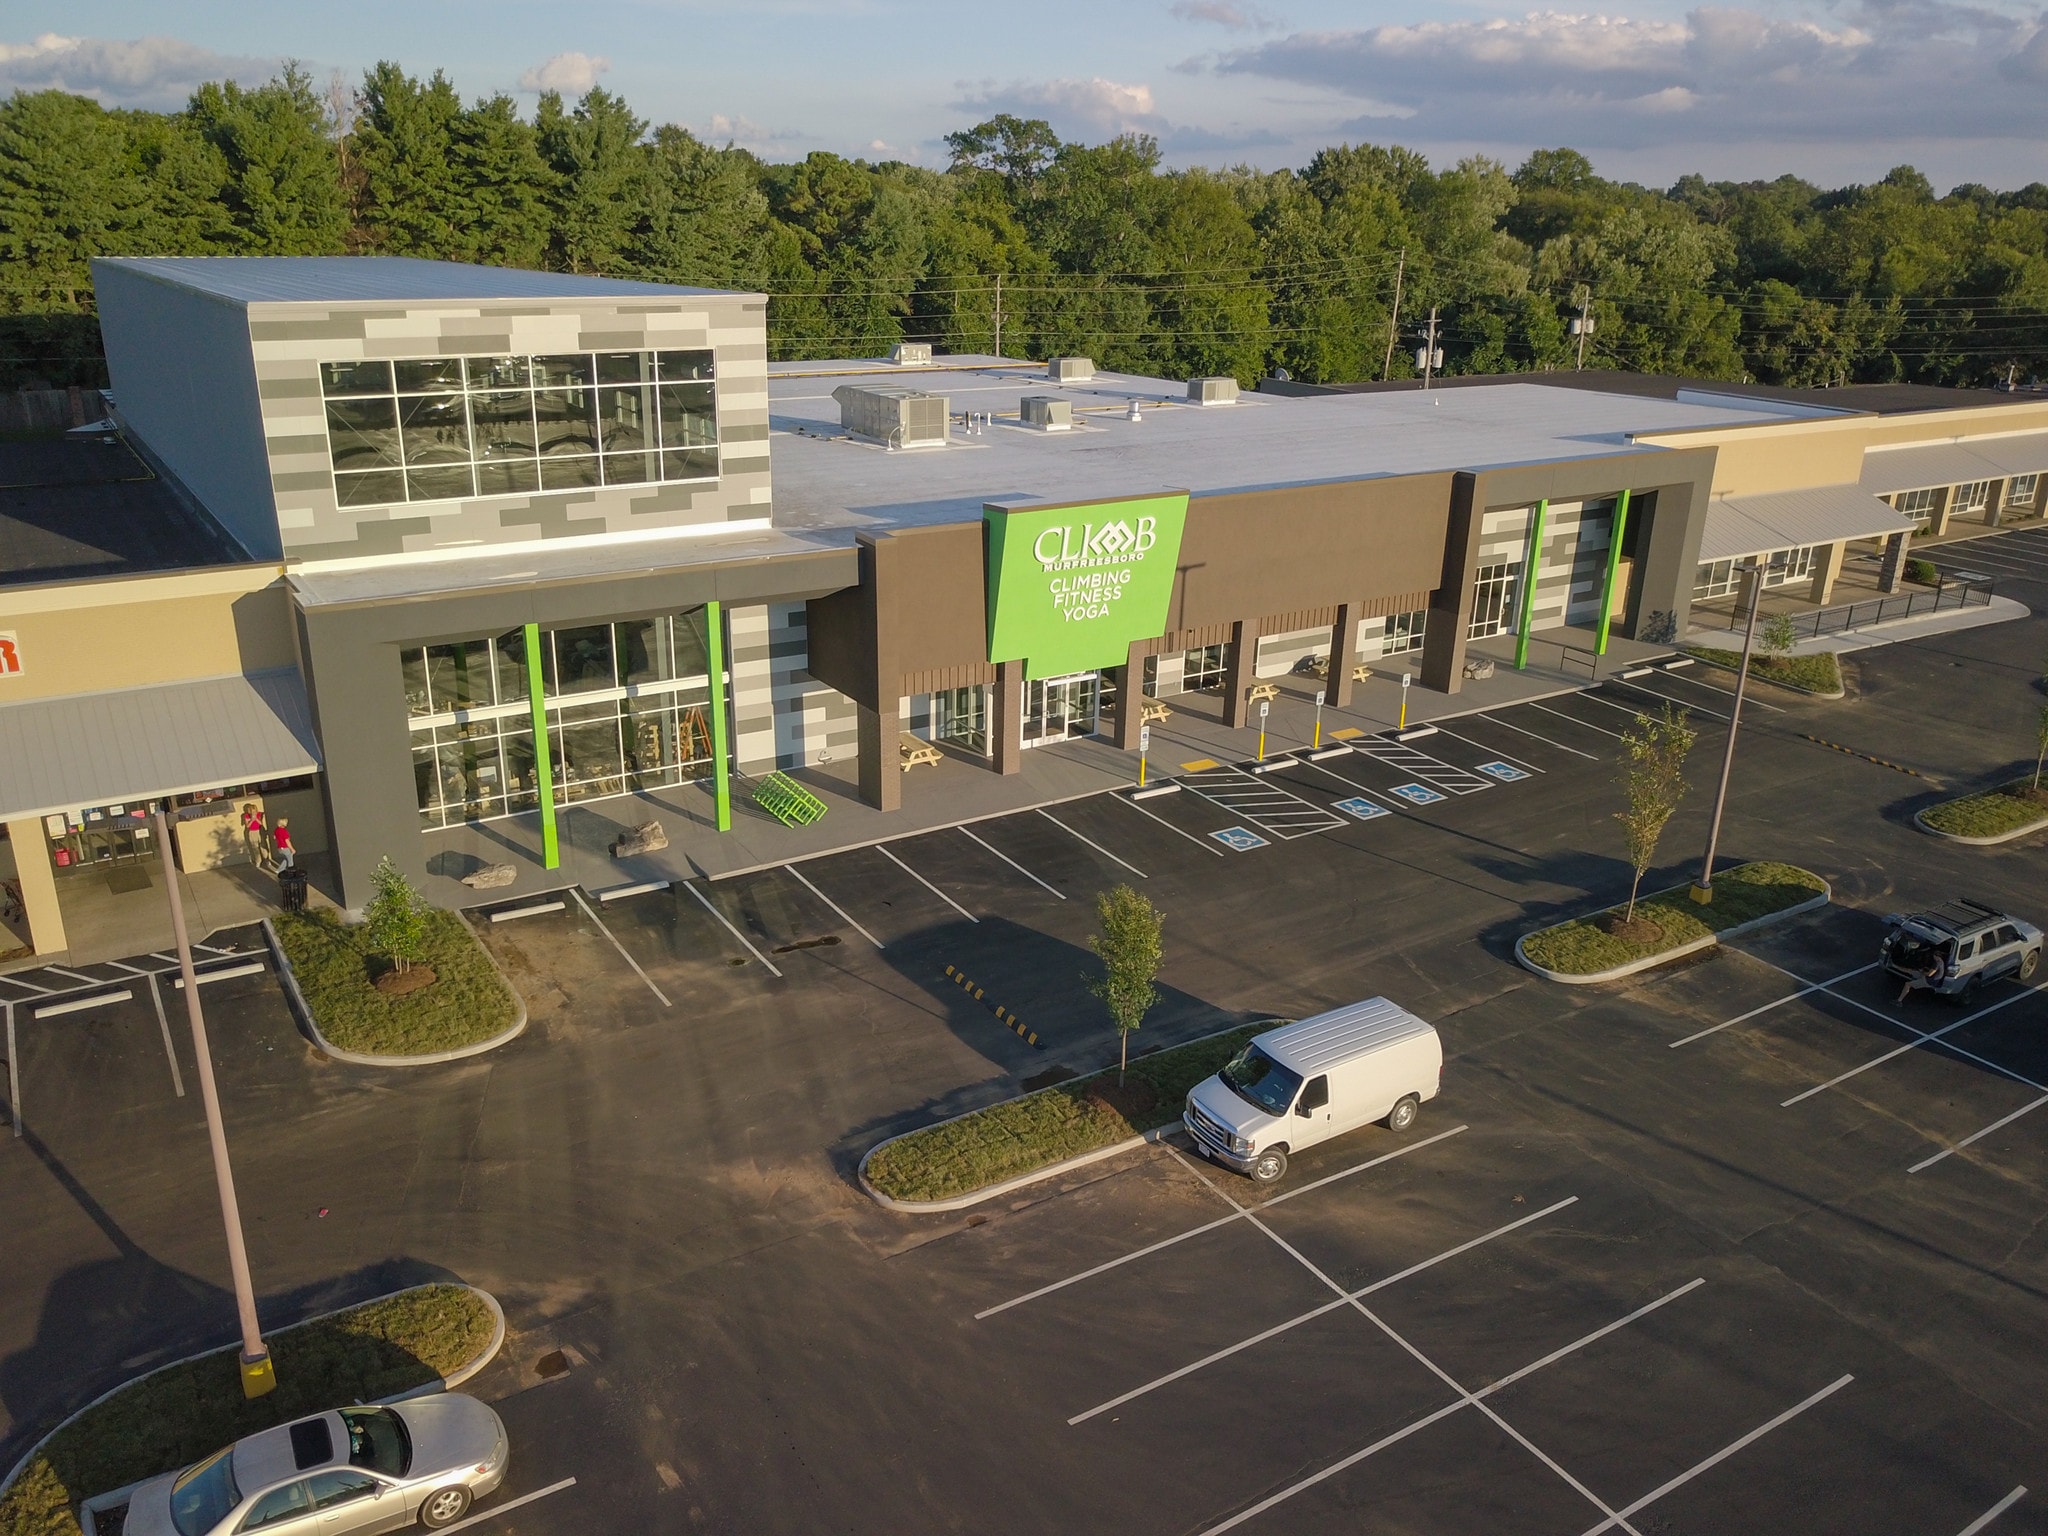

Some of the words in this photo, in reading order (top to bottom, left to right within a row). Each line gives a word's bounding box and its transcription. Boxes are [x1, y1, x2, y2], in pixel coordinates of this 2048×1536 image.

[1043, 553, 1144, 572] MURFREESBORO
[1049, 569, 1131, 594] CLIMBING
[1053, 586, 1122, 609] FITNESS
[1063, 604, 1109, 622] YOGA
